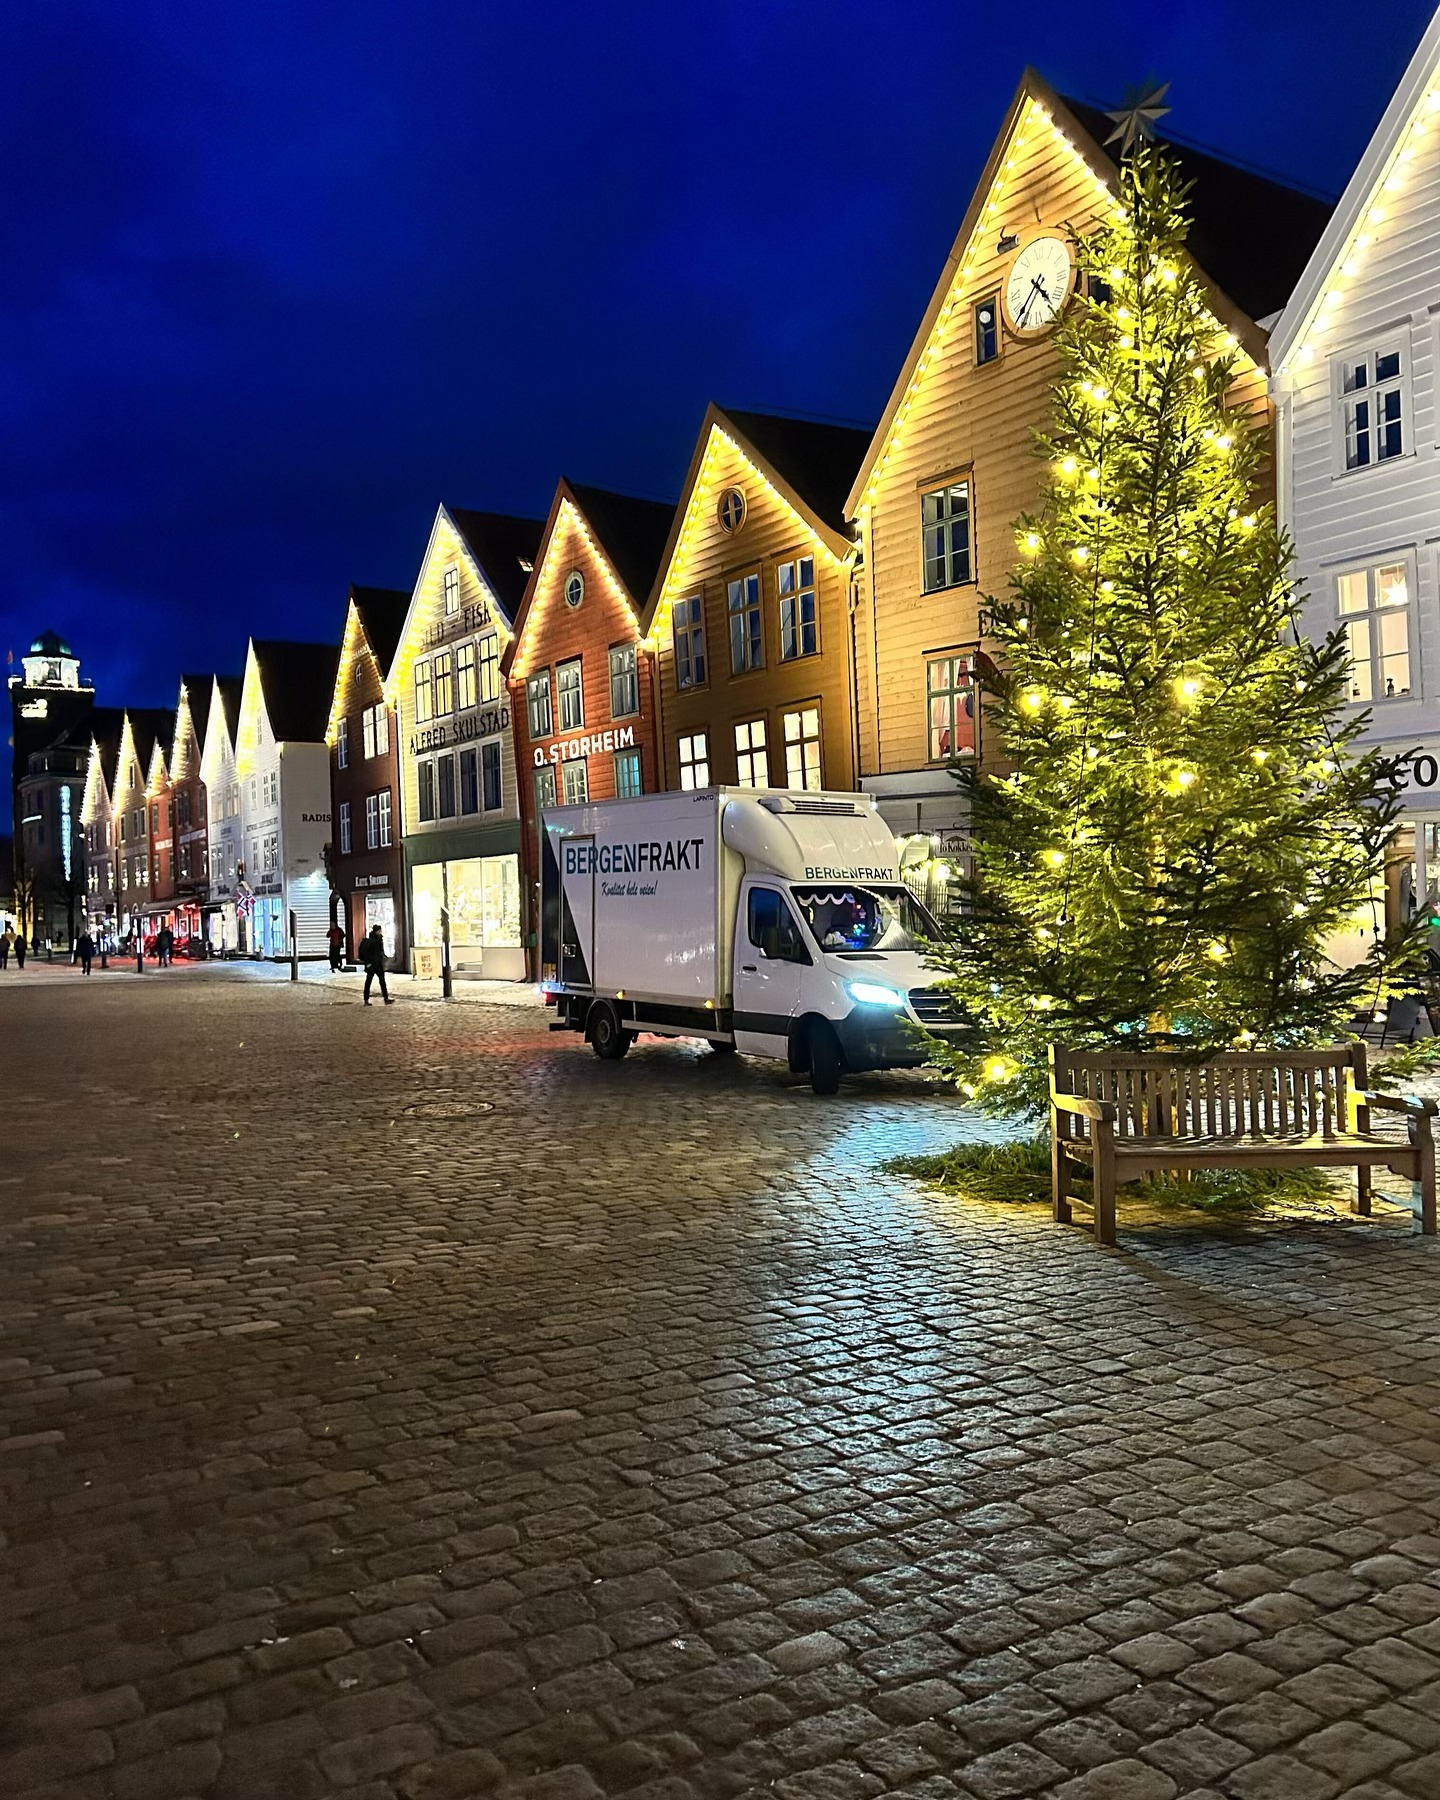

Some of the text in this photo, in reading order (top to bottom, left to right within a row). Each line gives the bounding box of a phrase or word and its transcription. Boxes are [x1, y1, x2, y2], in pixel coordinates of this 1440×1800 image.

[464, 600, 492, 633] FISK
[410, 707, 510, 755] ALFRED SKULSTAD
[302, 813, 332, 822] RADIS
[566, 838, 704, 875] BERGENFRAKT
[805, 866, 893, 880] BERGENFRAKT
[601, 879, 659, 897] Kvalitet hele veien!
